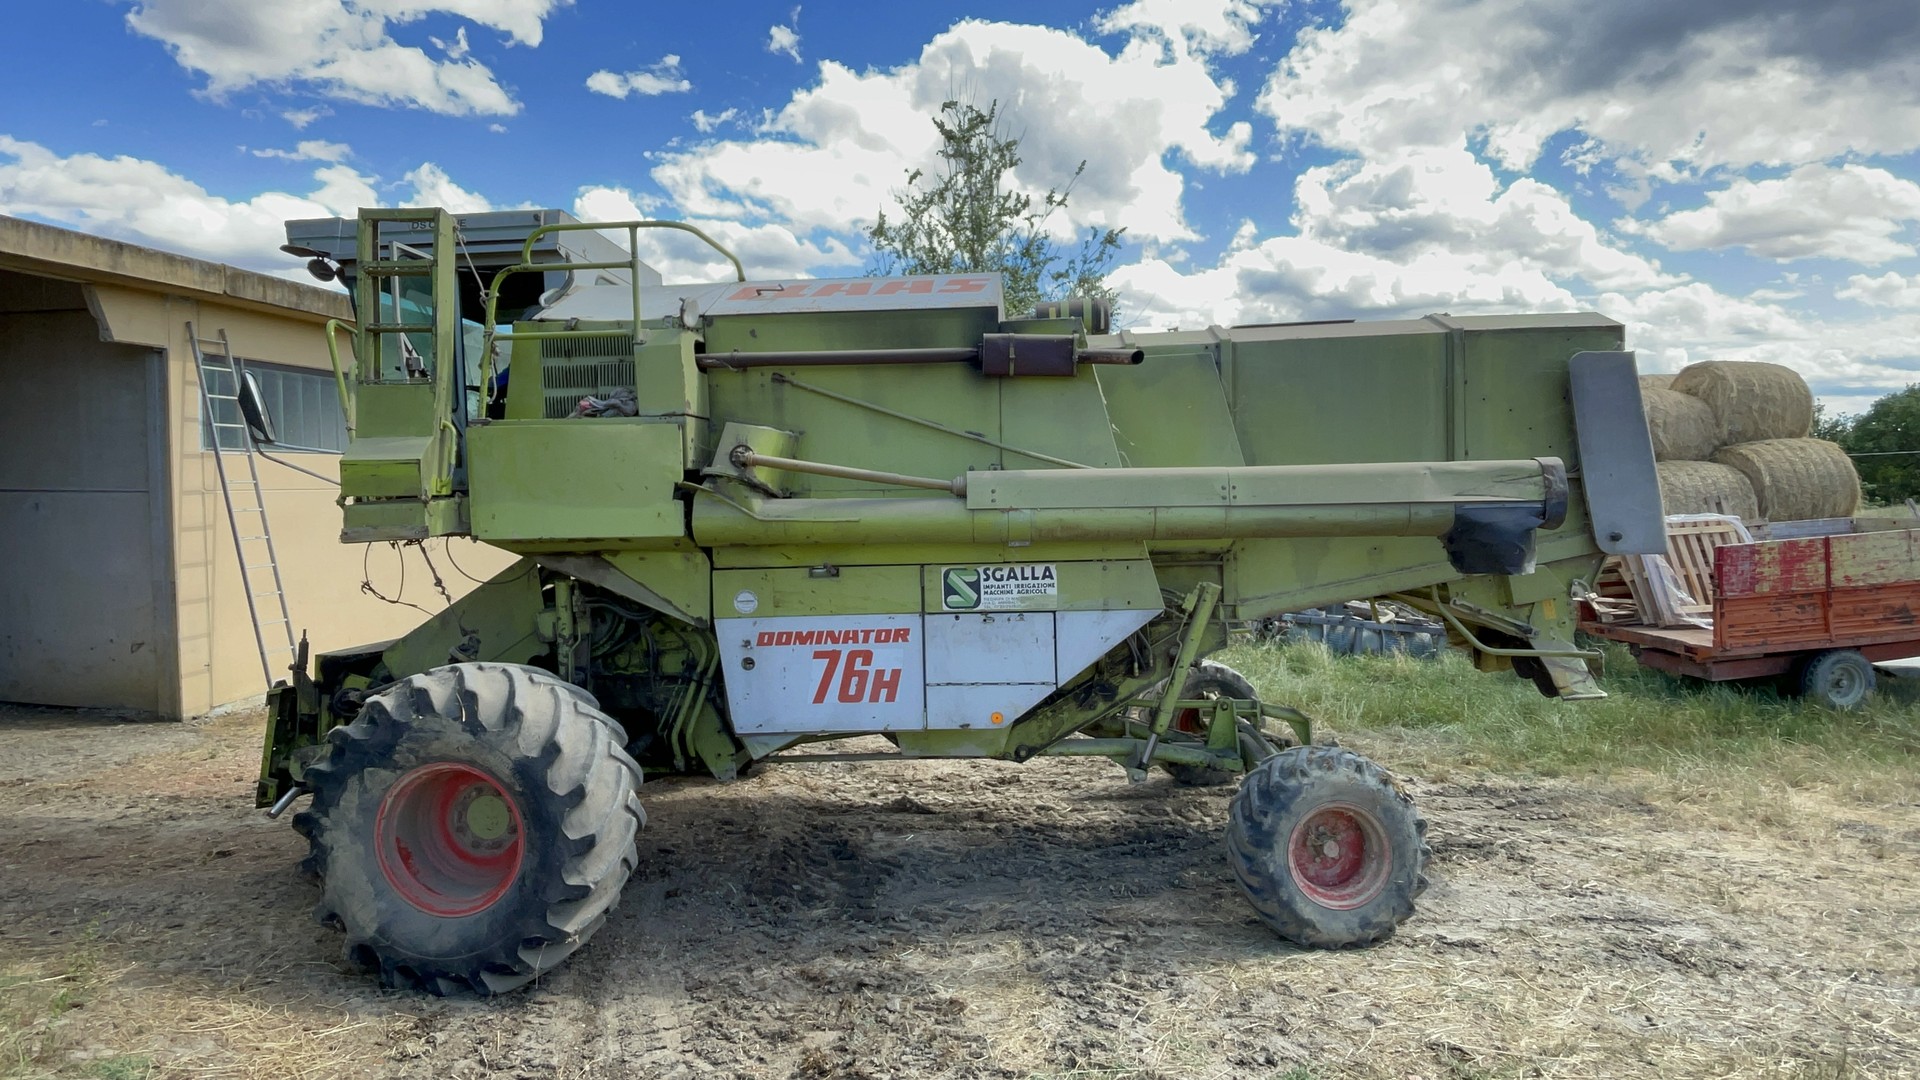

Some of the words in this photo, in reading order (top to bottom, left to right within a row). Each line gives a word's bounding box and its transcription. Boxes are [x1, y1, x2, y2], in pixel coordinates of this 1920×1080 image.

[983, 566, 1055, 581] SGALLA
[756, 628, 911, 647] DOMINATOR
[812, 649, 902, 704] 76H
